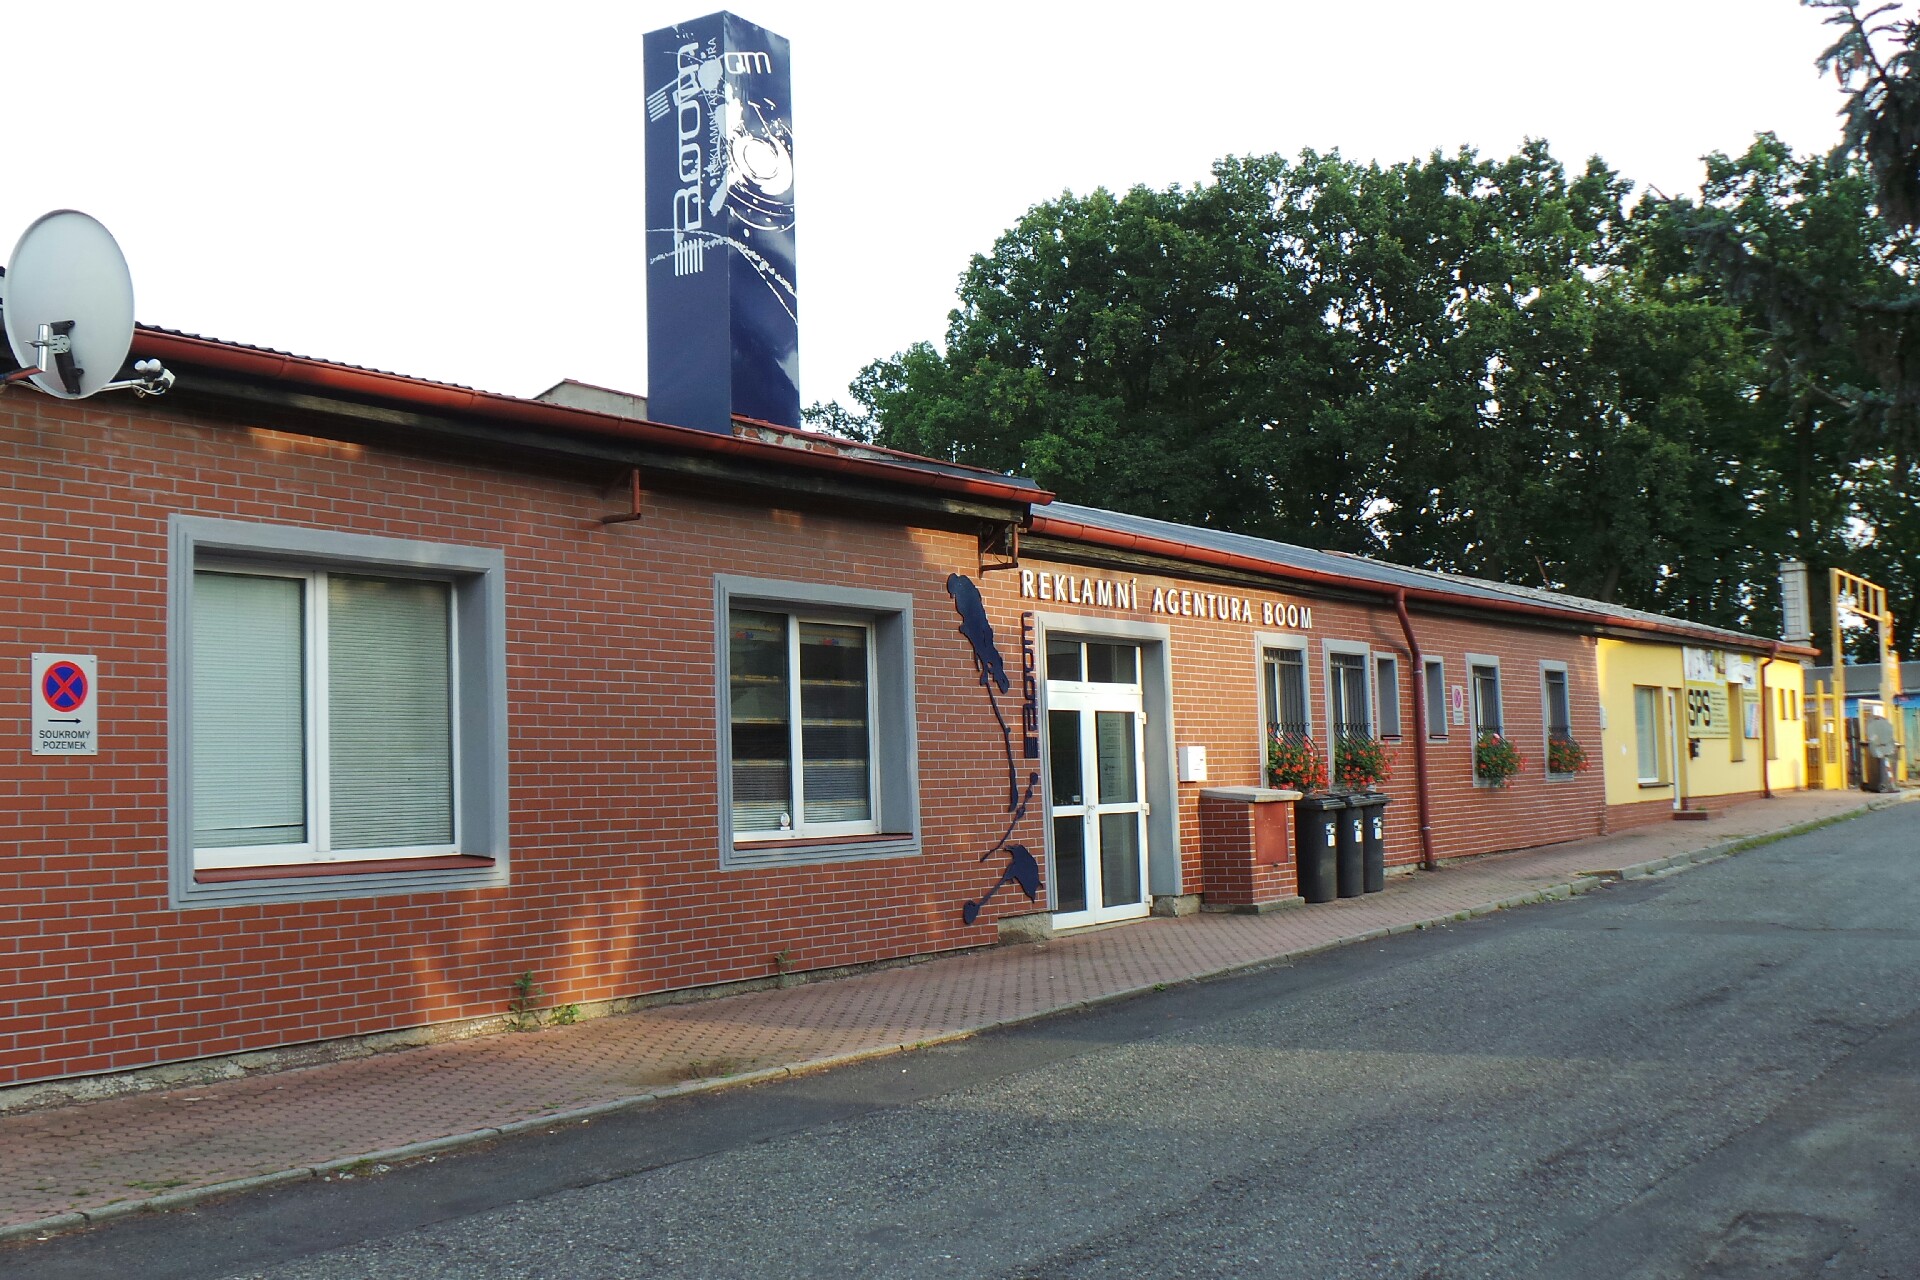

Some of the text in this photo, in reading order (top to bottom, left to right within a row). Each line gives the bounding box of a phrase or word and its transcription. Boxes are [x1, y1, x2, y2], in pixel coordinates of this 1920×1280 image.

[1021, 569, 1312, 629] REKLAMNÍ AGENTURA BOOM
[1688, 689, 1710, 726] SPS
[43, 741, 86, 750] POZEMEK
